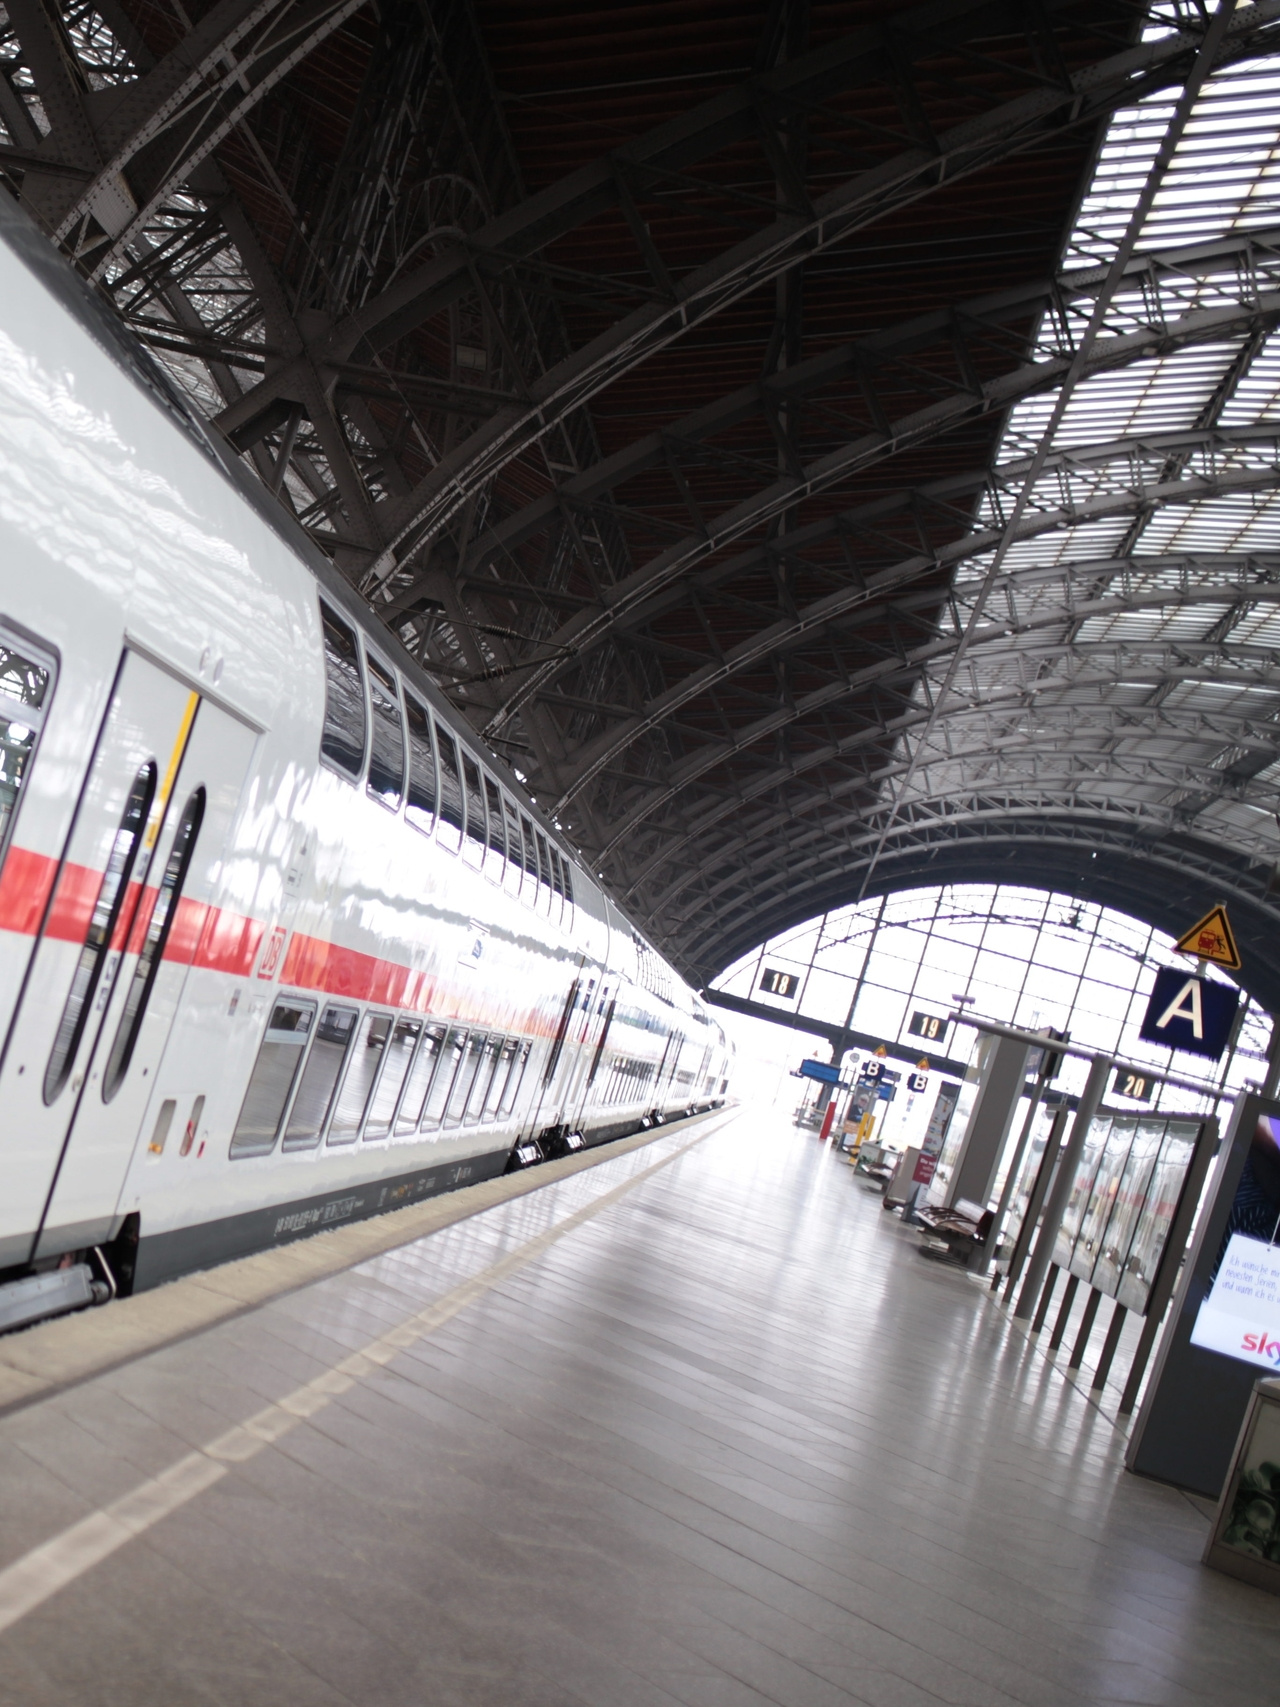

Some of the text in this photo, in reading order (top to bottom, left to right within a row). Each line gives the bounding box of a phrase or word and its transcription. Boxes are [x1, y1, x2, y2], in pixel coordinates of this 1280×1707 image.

[260, 934, 284, 973] DB
[771, 973, 790, 995] 18
[1155, 978, 1203, 1039] A
[920, 1016, 940, 1038] 19
[866, 1061, 880, 1077] B
[913, 1075, 927, 1090] B
[1123, 1075, 1145, 1098] 20
